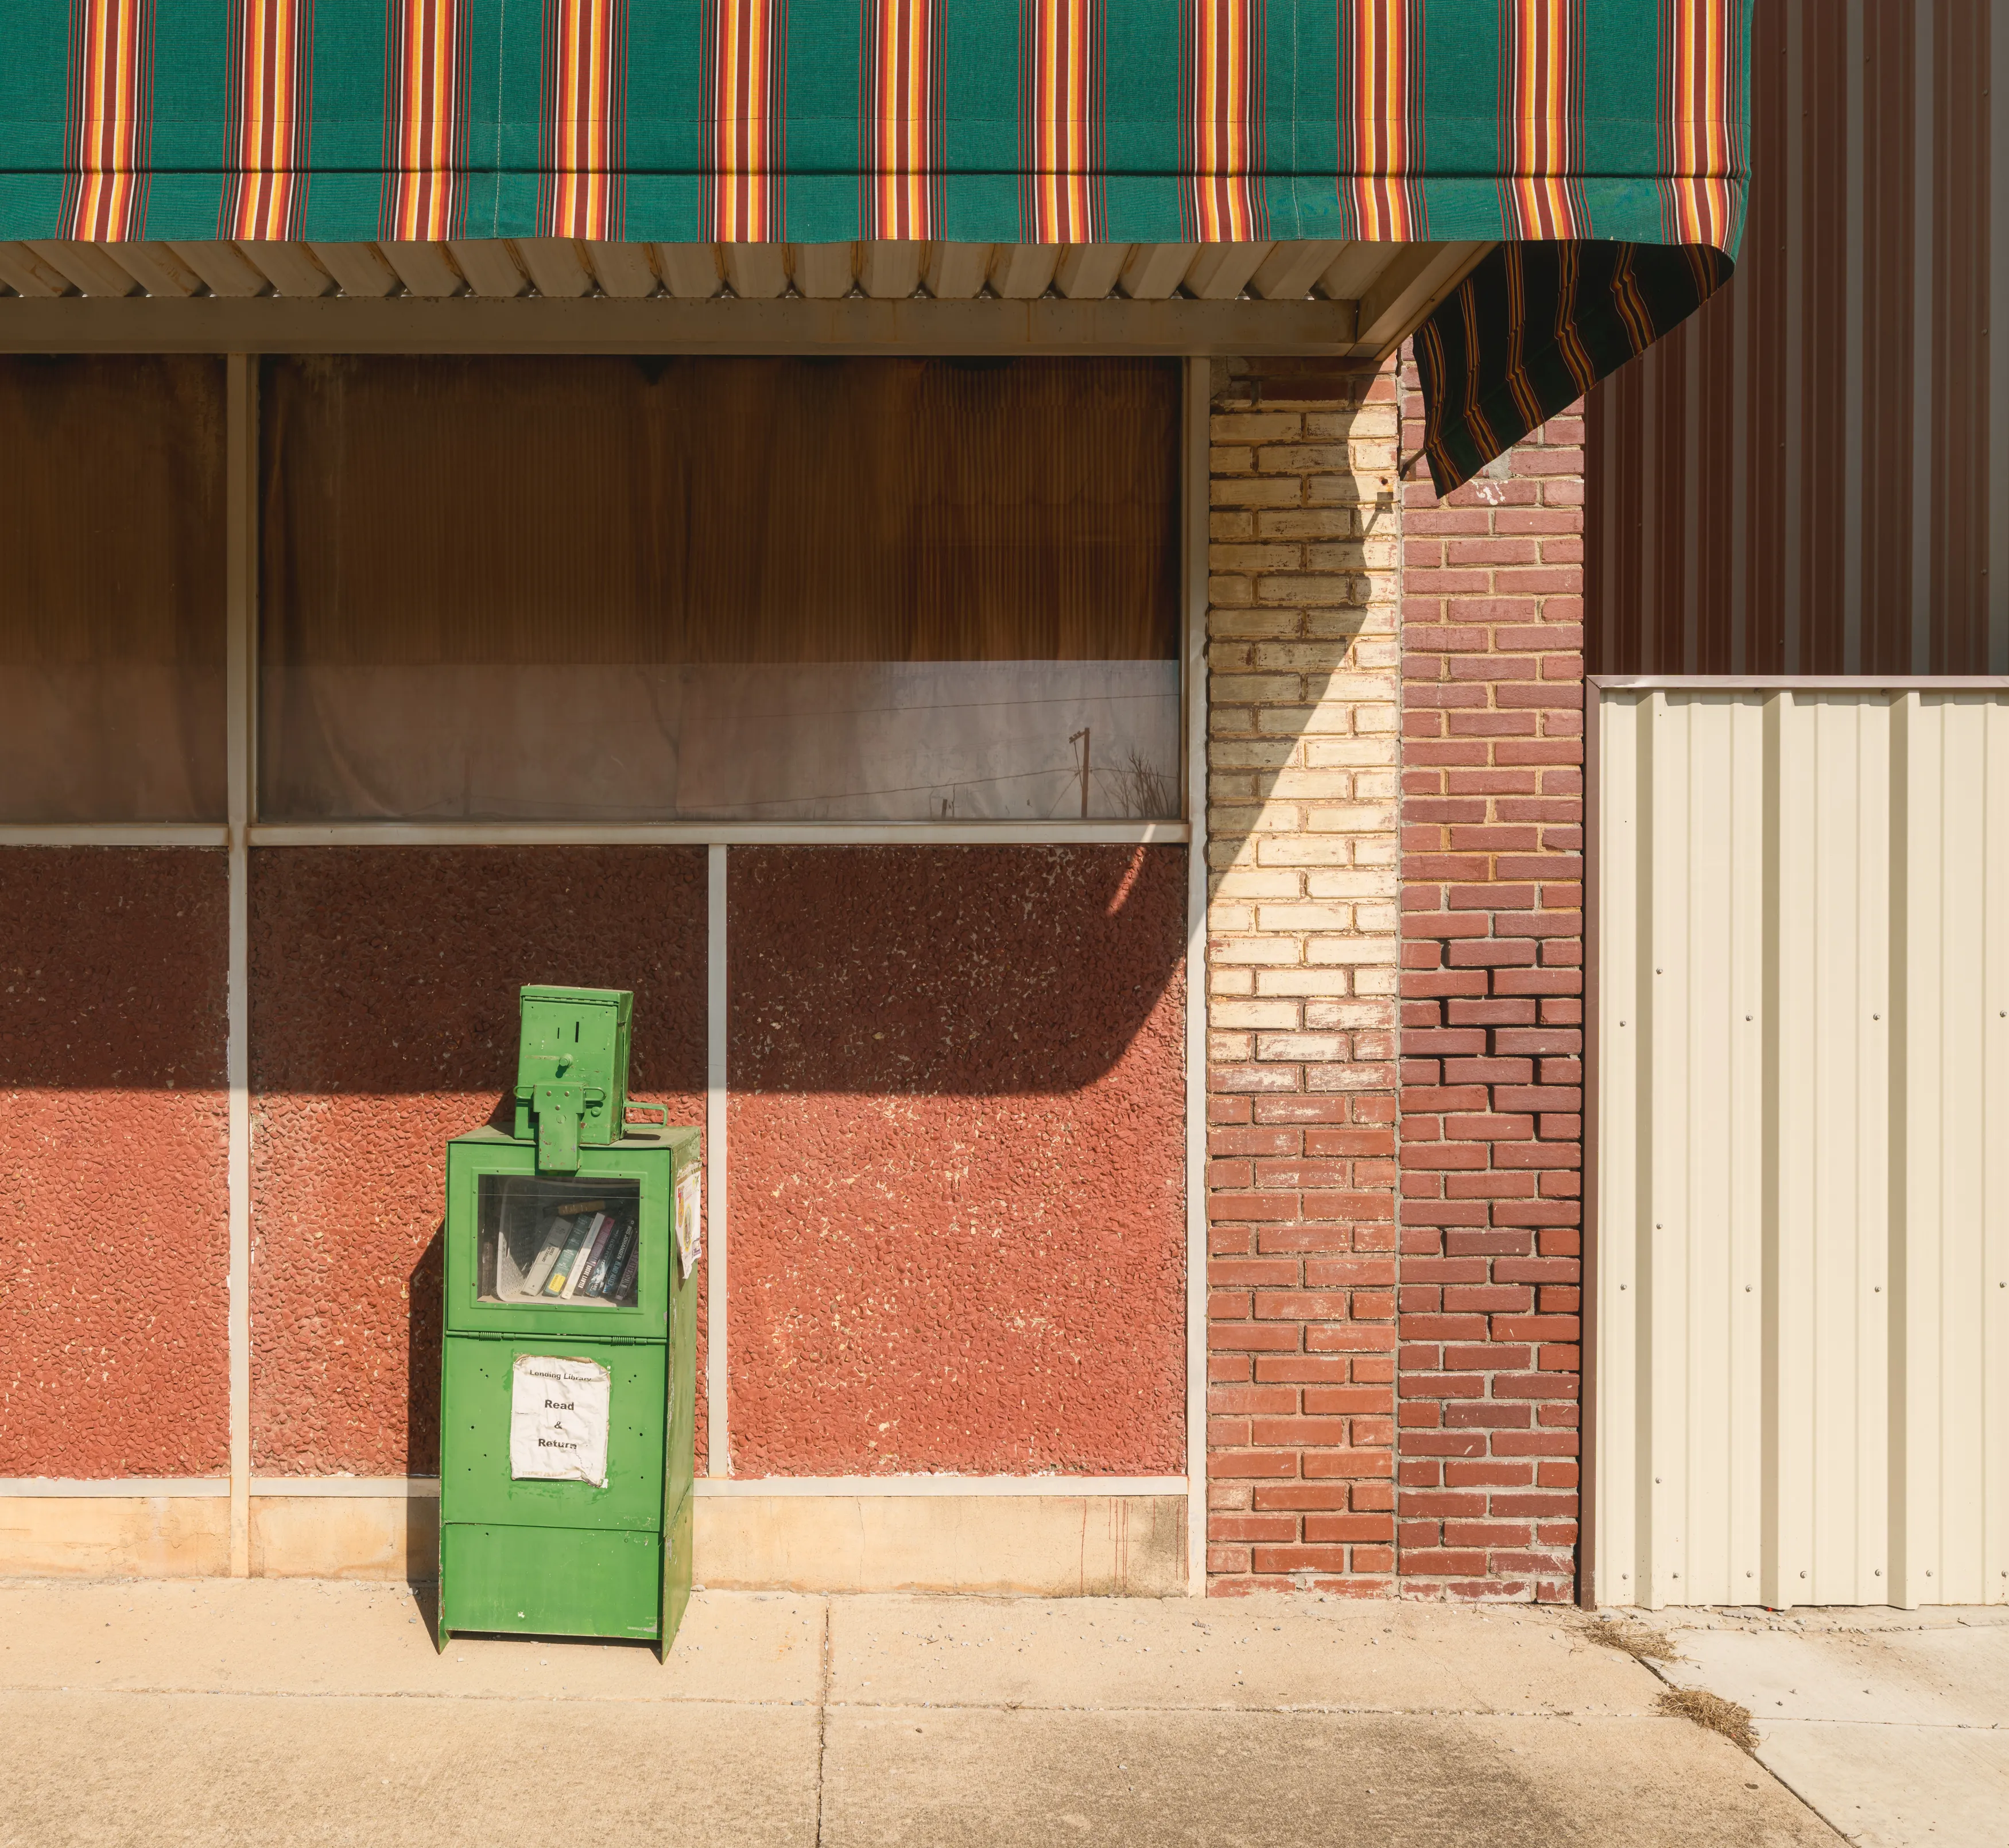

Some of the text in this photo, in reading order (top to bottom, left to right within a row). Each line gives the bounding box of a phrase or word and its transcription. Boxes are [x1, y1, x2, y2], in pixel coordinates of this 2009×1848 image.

[616, 1234, 629, 1260] JOHANSEN
[583, 1264, 592, 1276] ROGUE
[611, 1260, 620, 1273] BLIND
[621, 1256, 637, 1287] PATTERSON
[577, 1274, 588, 1289] LAWYER
[607, 1272, 616, 1287] ALLEY
[530, 1370, 592, 1382] Lending Library
[545, 1400, 574, 1411] Read
[554, 1421, 563, 1429] &
[538, 1439, 577, 1450] Return
